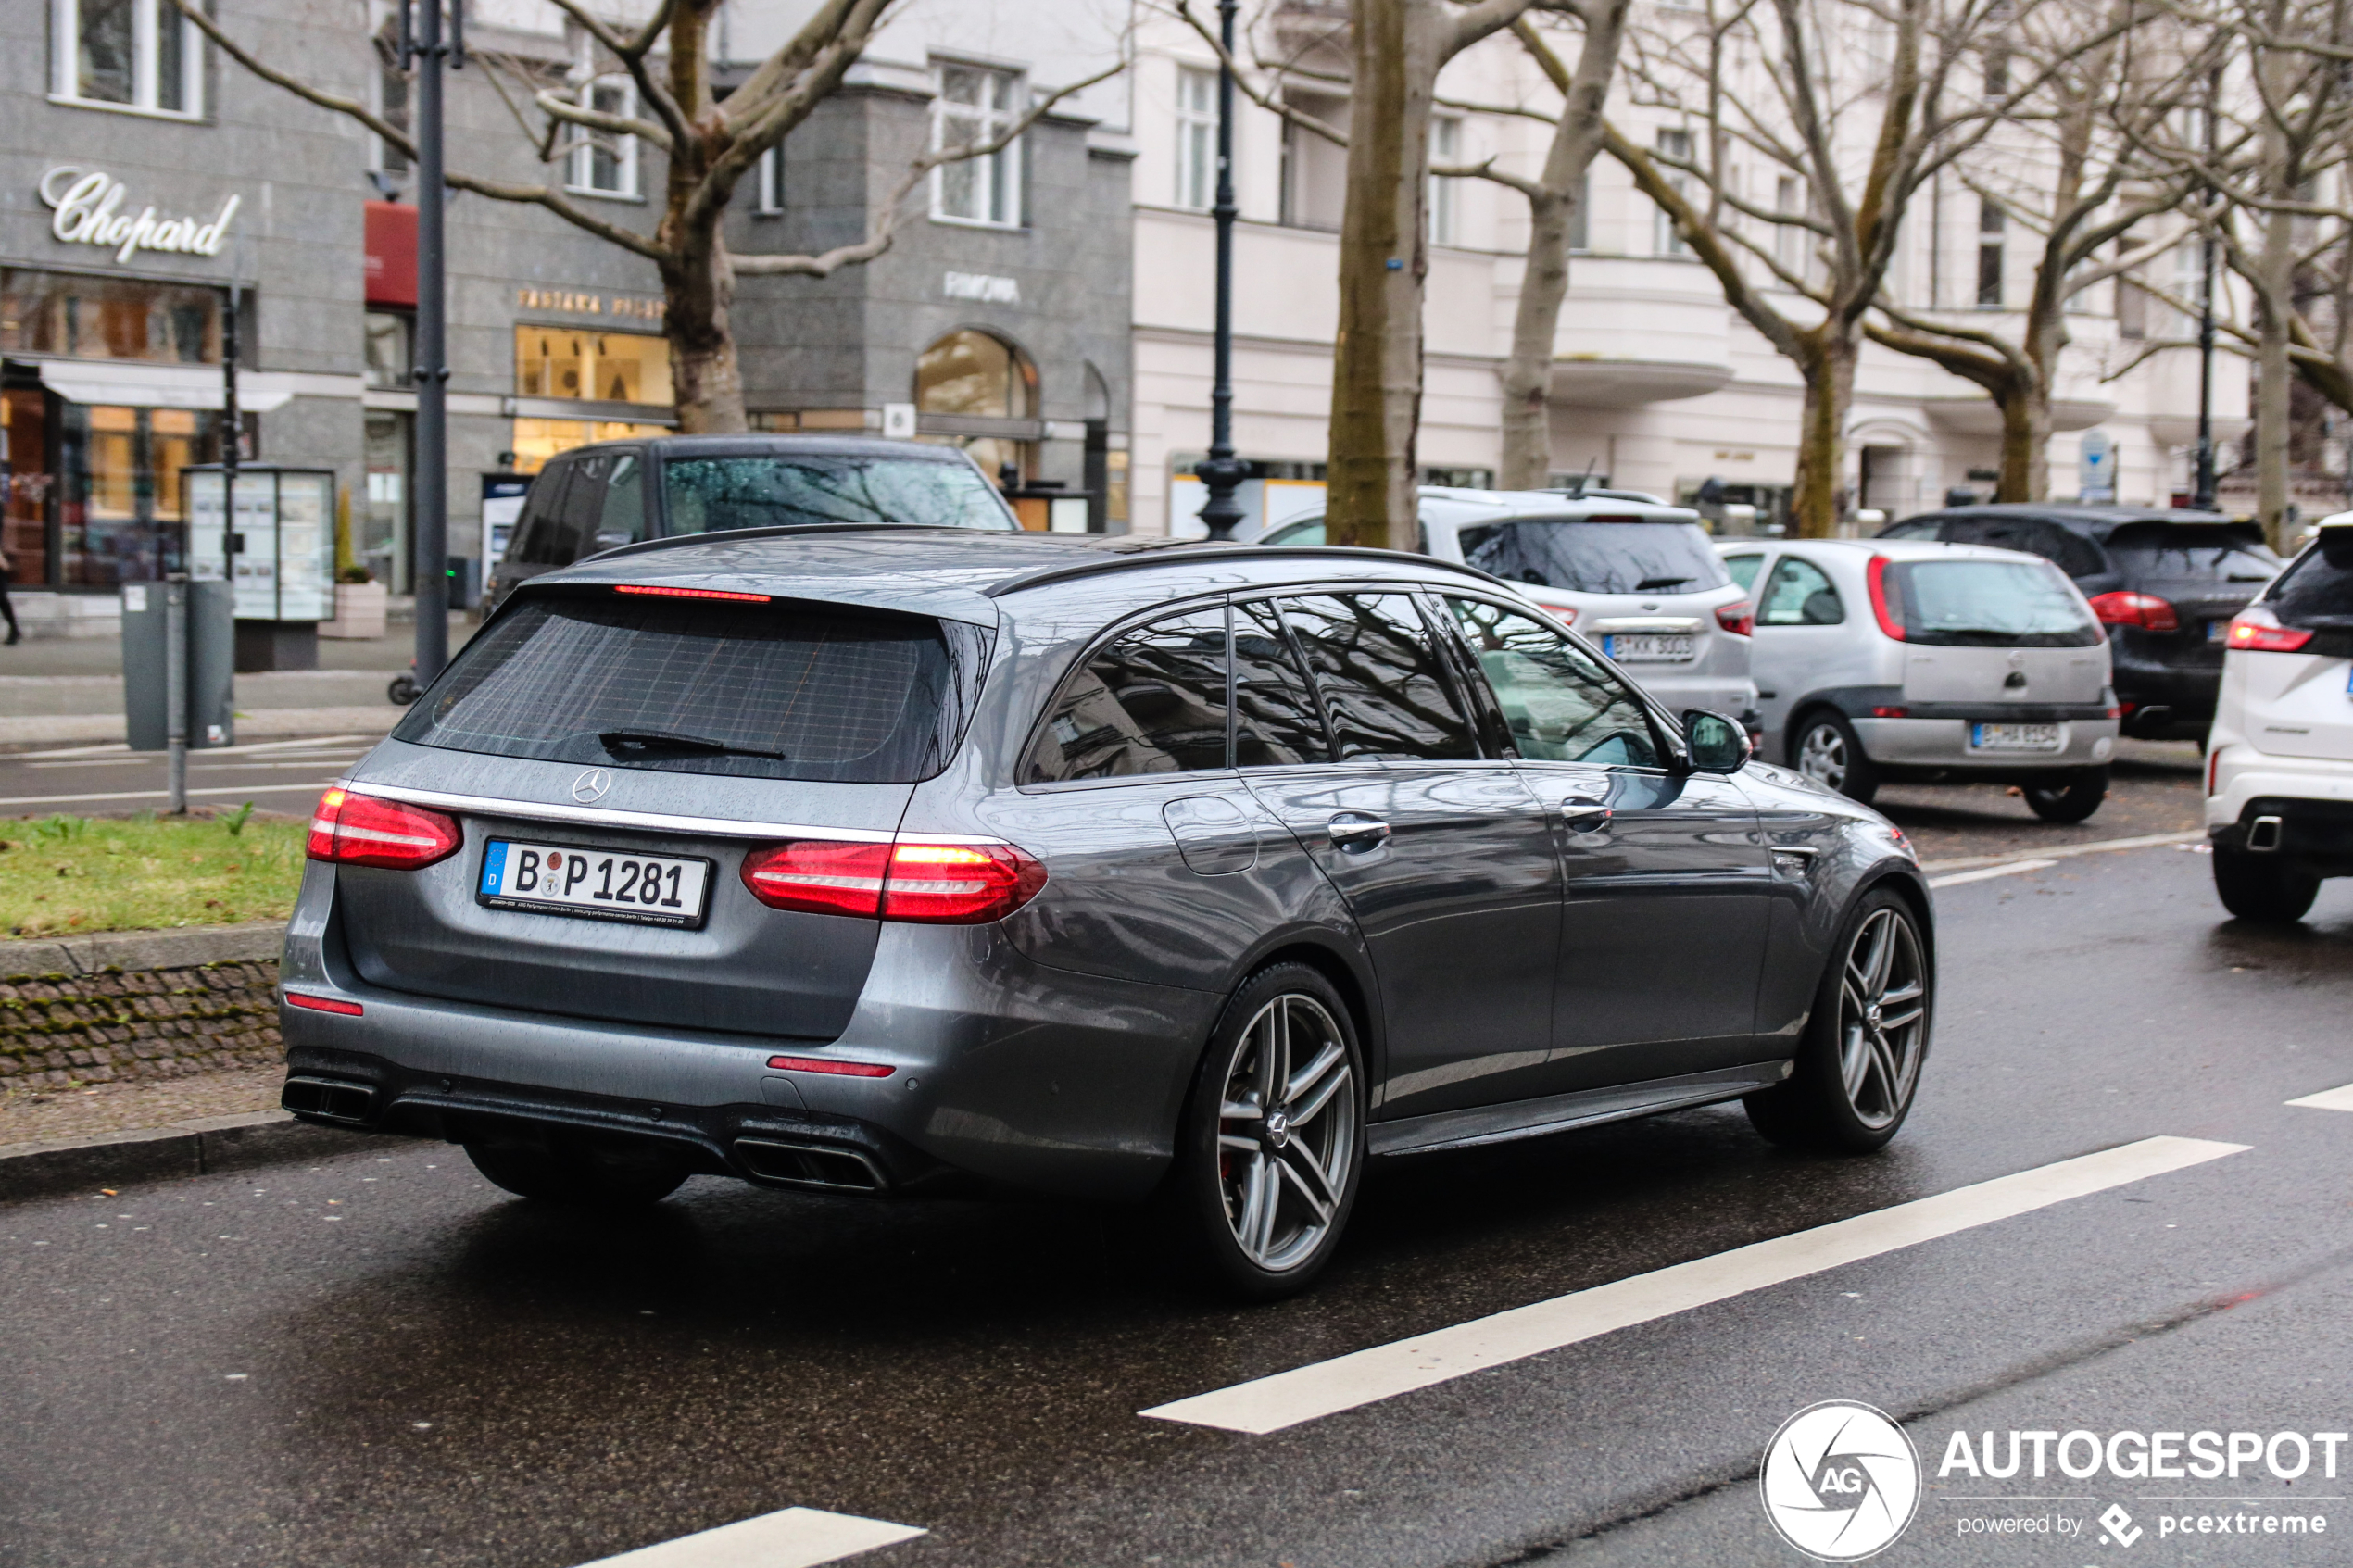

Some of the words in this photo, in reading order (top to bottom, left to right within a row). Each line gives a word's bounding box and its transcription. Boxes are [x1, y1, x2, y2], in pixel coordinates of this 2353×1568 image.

[40, 166, 243, 263] Chopard
[488, 874, 497, 886] D
[516, 850, 540, 891] B
[526, 903, 549, 911] Performance
